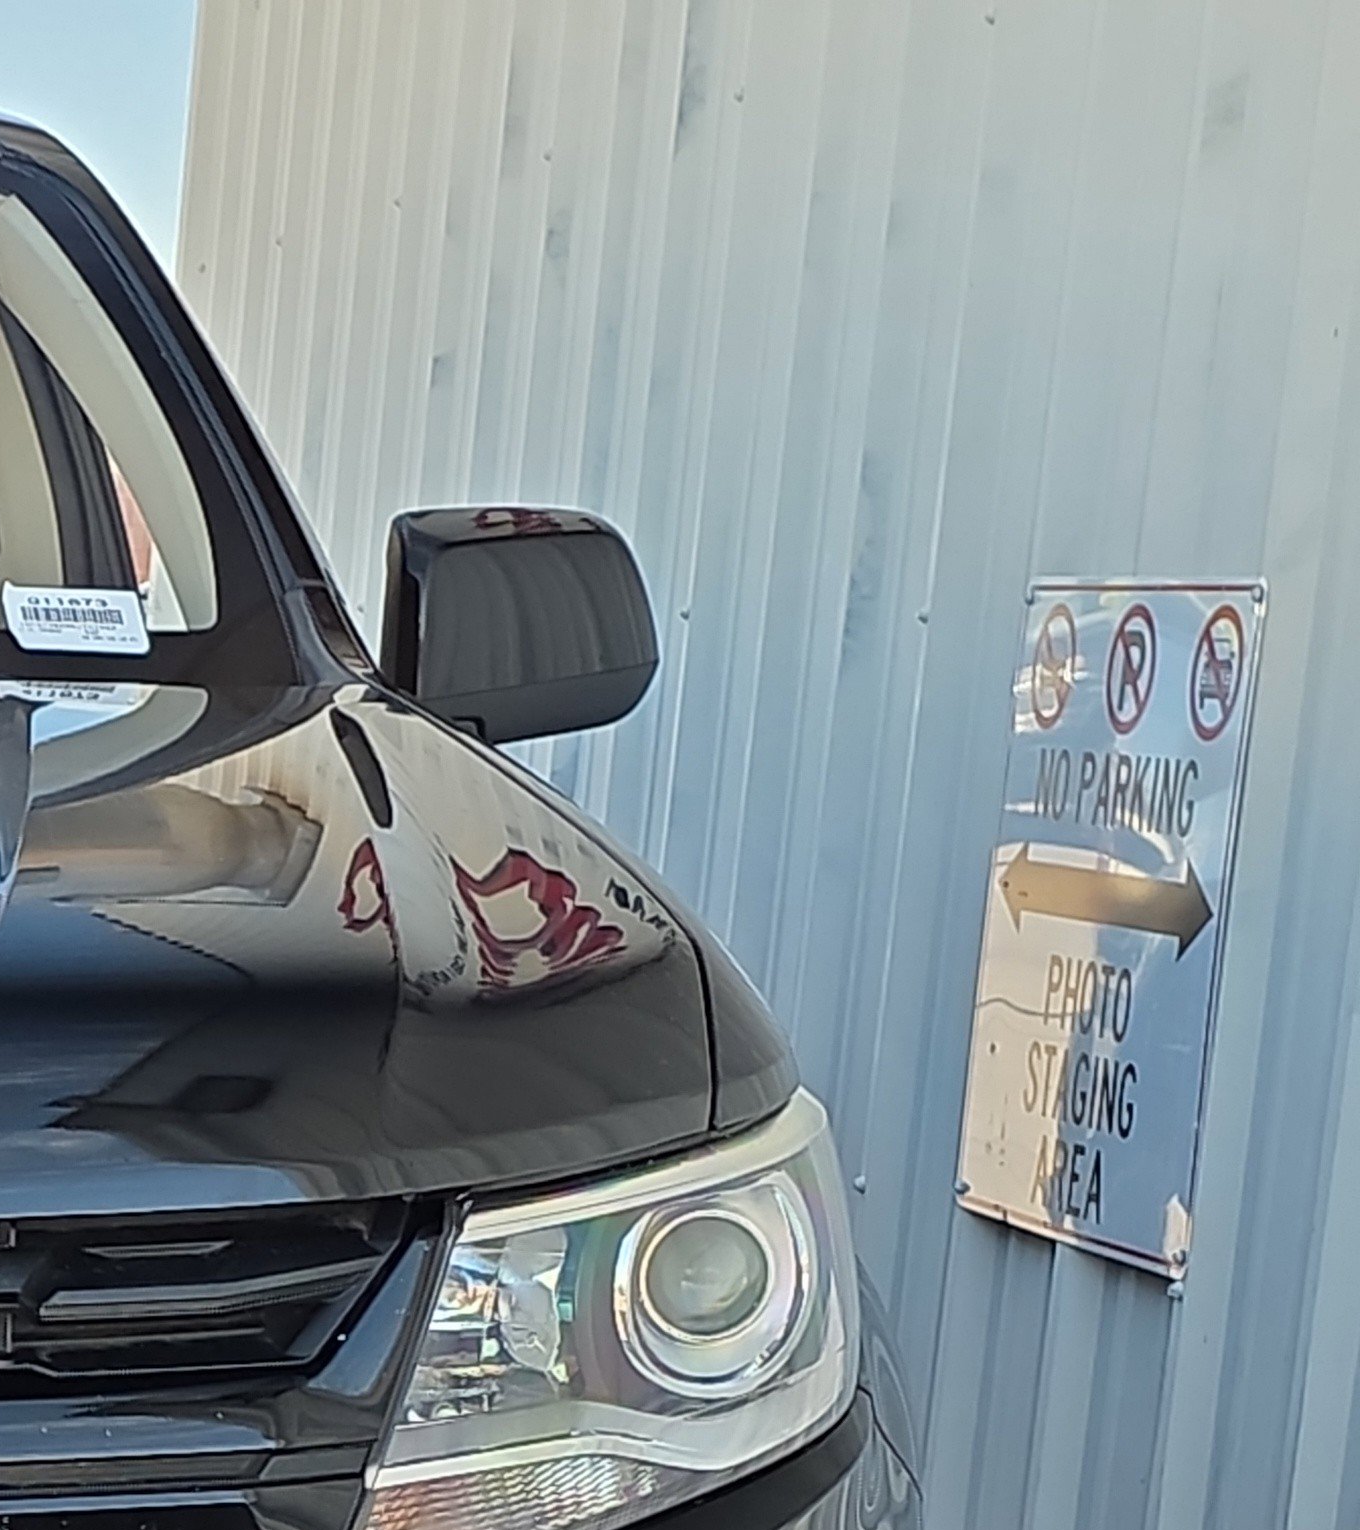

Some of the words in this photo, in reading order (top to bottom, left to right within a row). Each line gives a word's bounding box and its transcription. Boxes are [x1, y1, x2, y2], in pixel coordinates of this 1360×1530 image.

[1034, 748, 1071, 821] NO
[1075, 752, 1199, 838] PARKING
[1043, 953, 1132, 1043] PHOTO
[1022, 1040, 1137, 1140] STAGING
[1030, 1134, 1102, 1225] AREA
